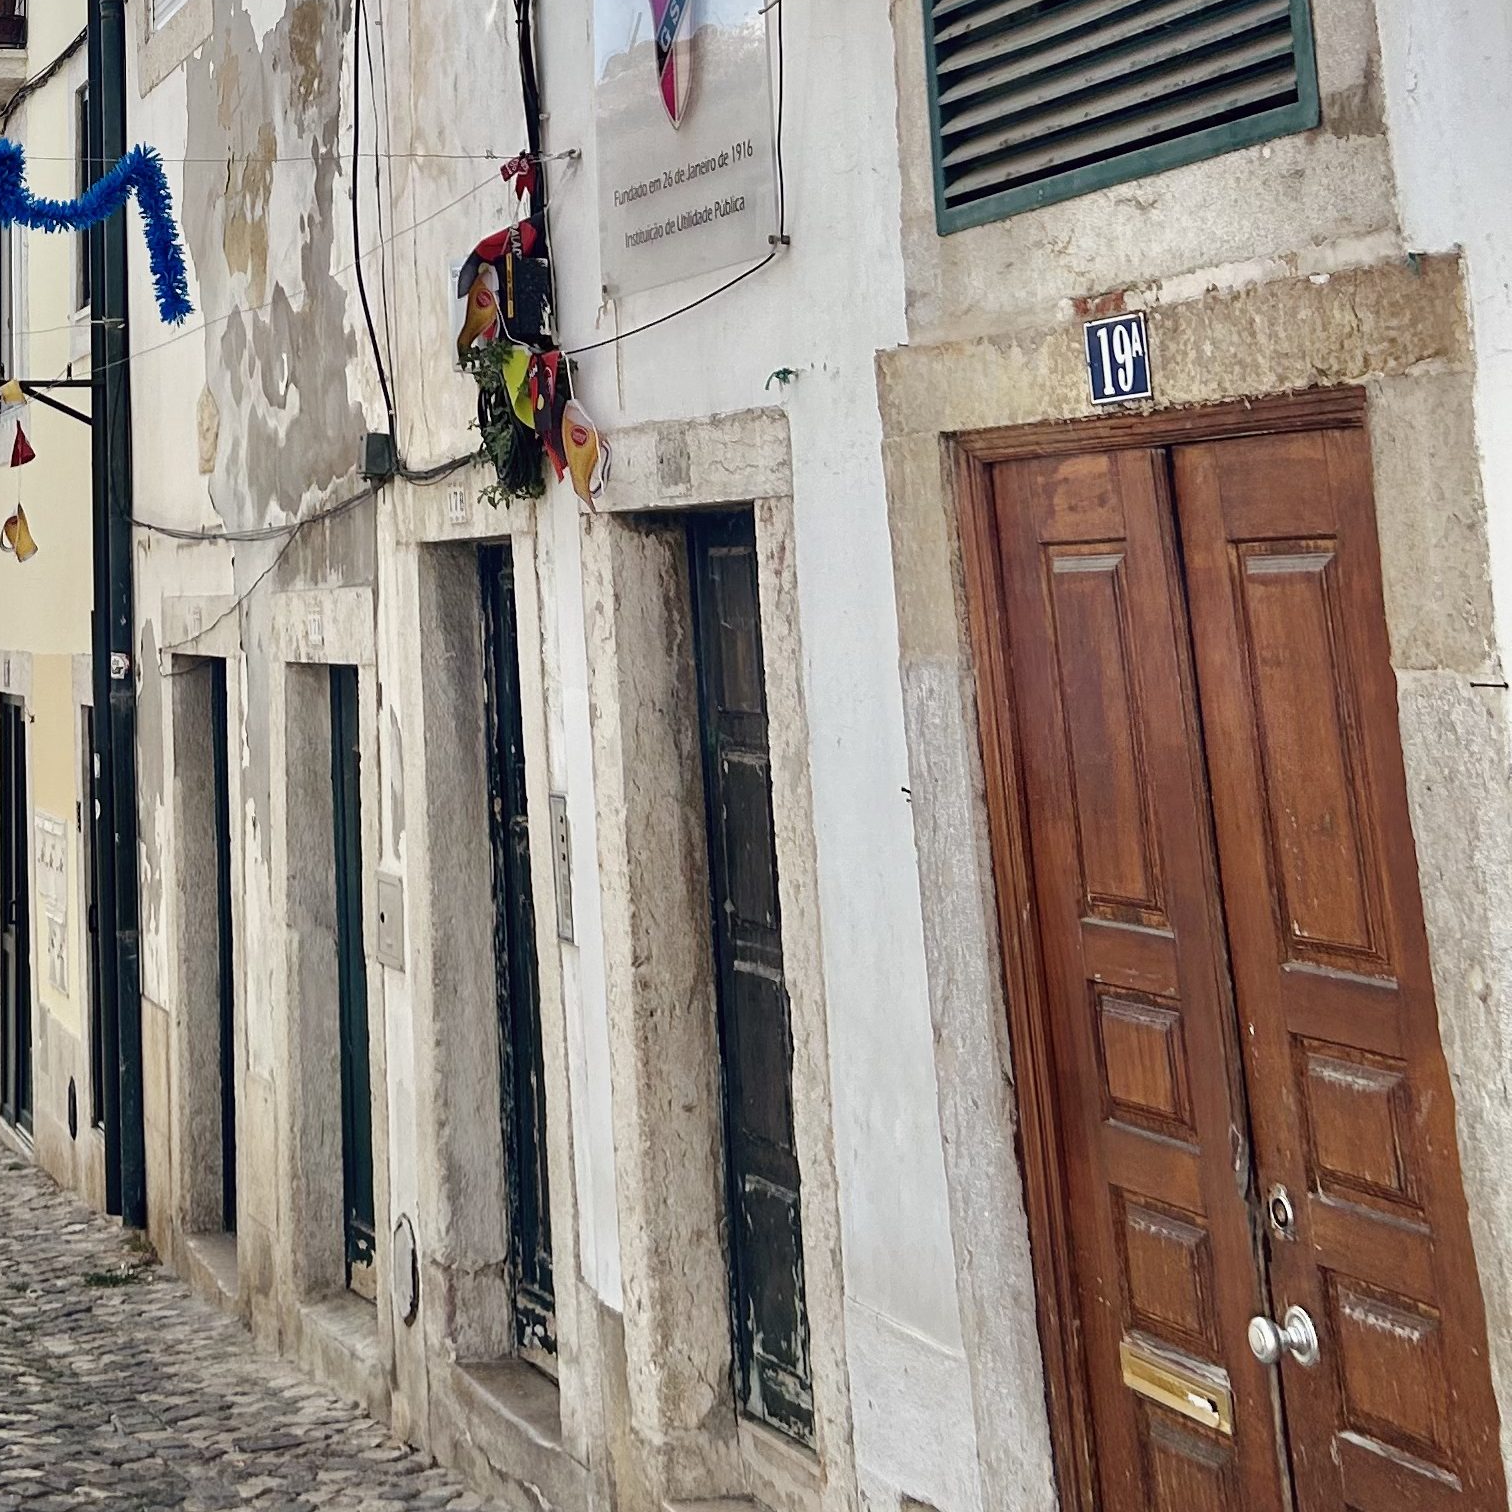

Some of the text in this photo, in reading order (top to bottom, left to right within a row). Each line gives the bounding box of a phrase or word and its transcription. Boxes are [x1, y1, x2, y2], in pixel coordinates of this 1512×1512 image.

[613, 139, 754, 207] Fundado em 26 de Janeiro de 1916
[664, 218, 676, 236] de
[676, 206, 713, 232] Utilidade
[714, 195, 746, 220] Pública
[1096, 321, 1144, 396] 19A
